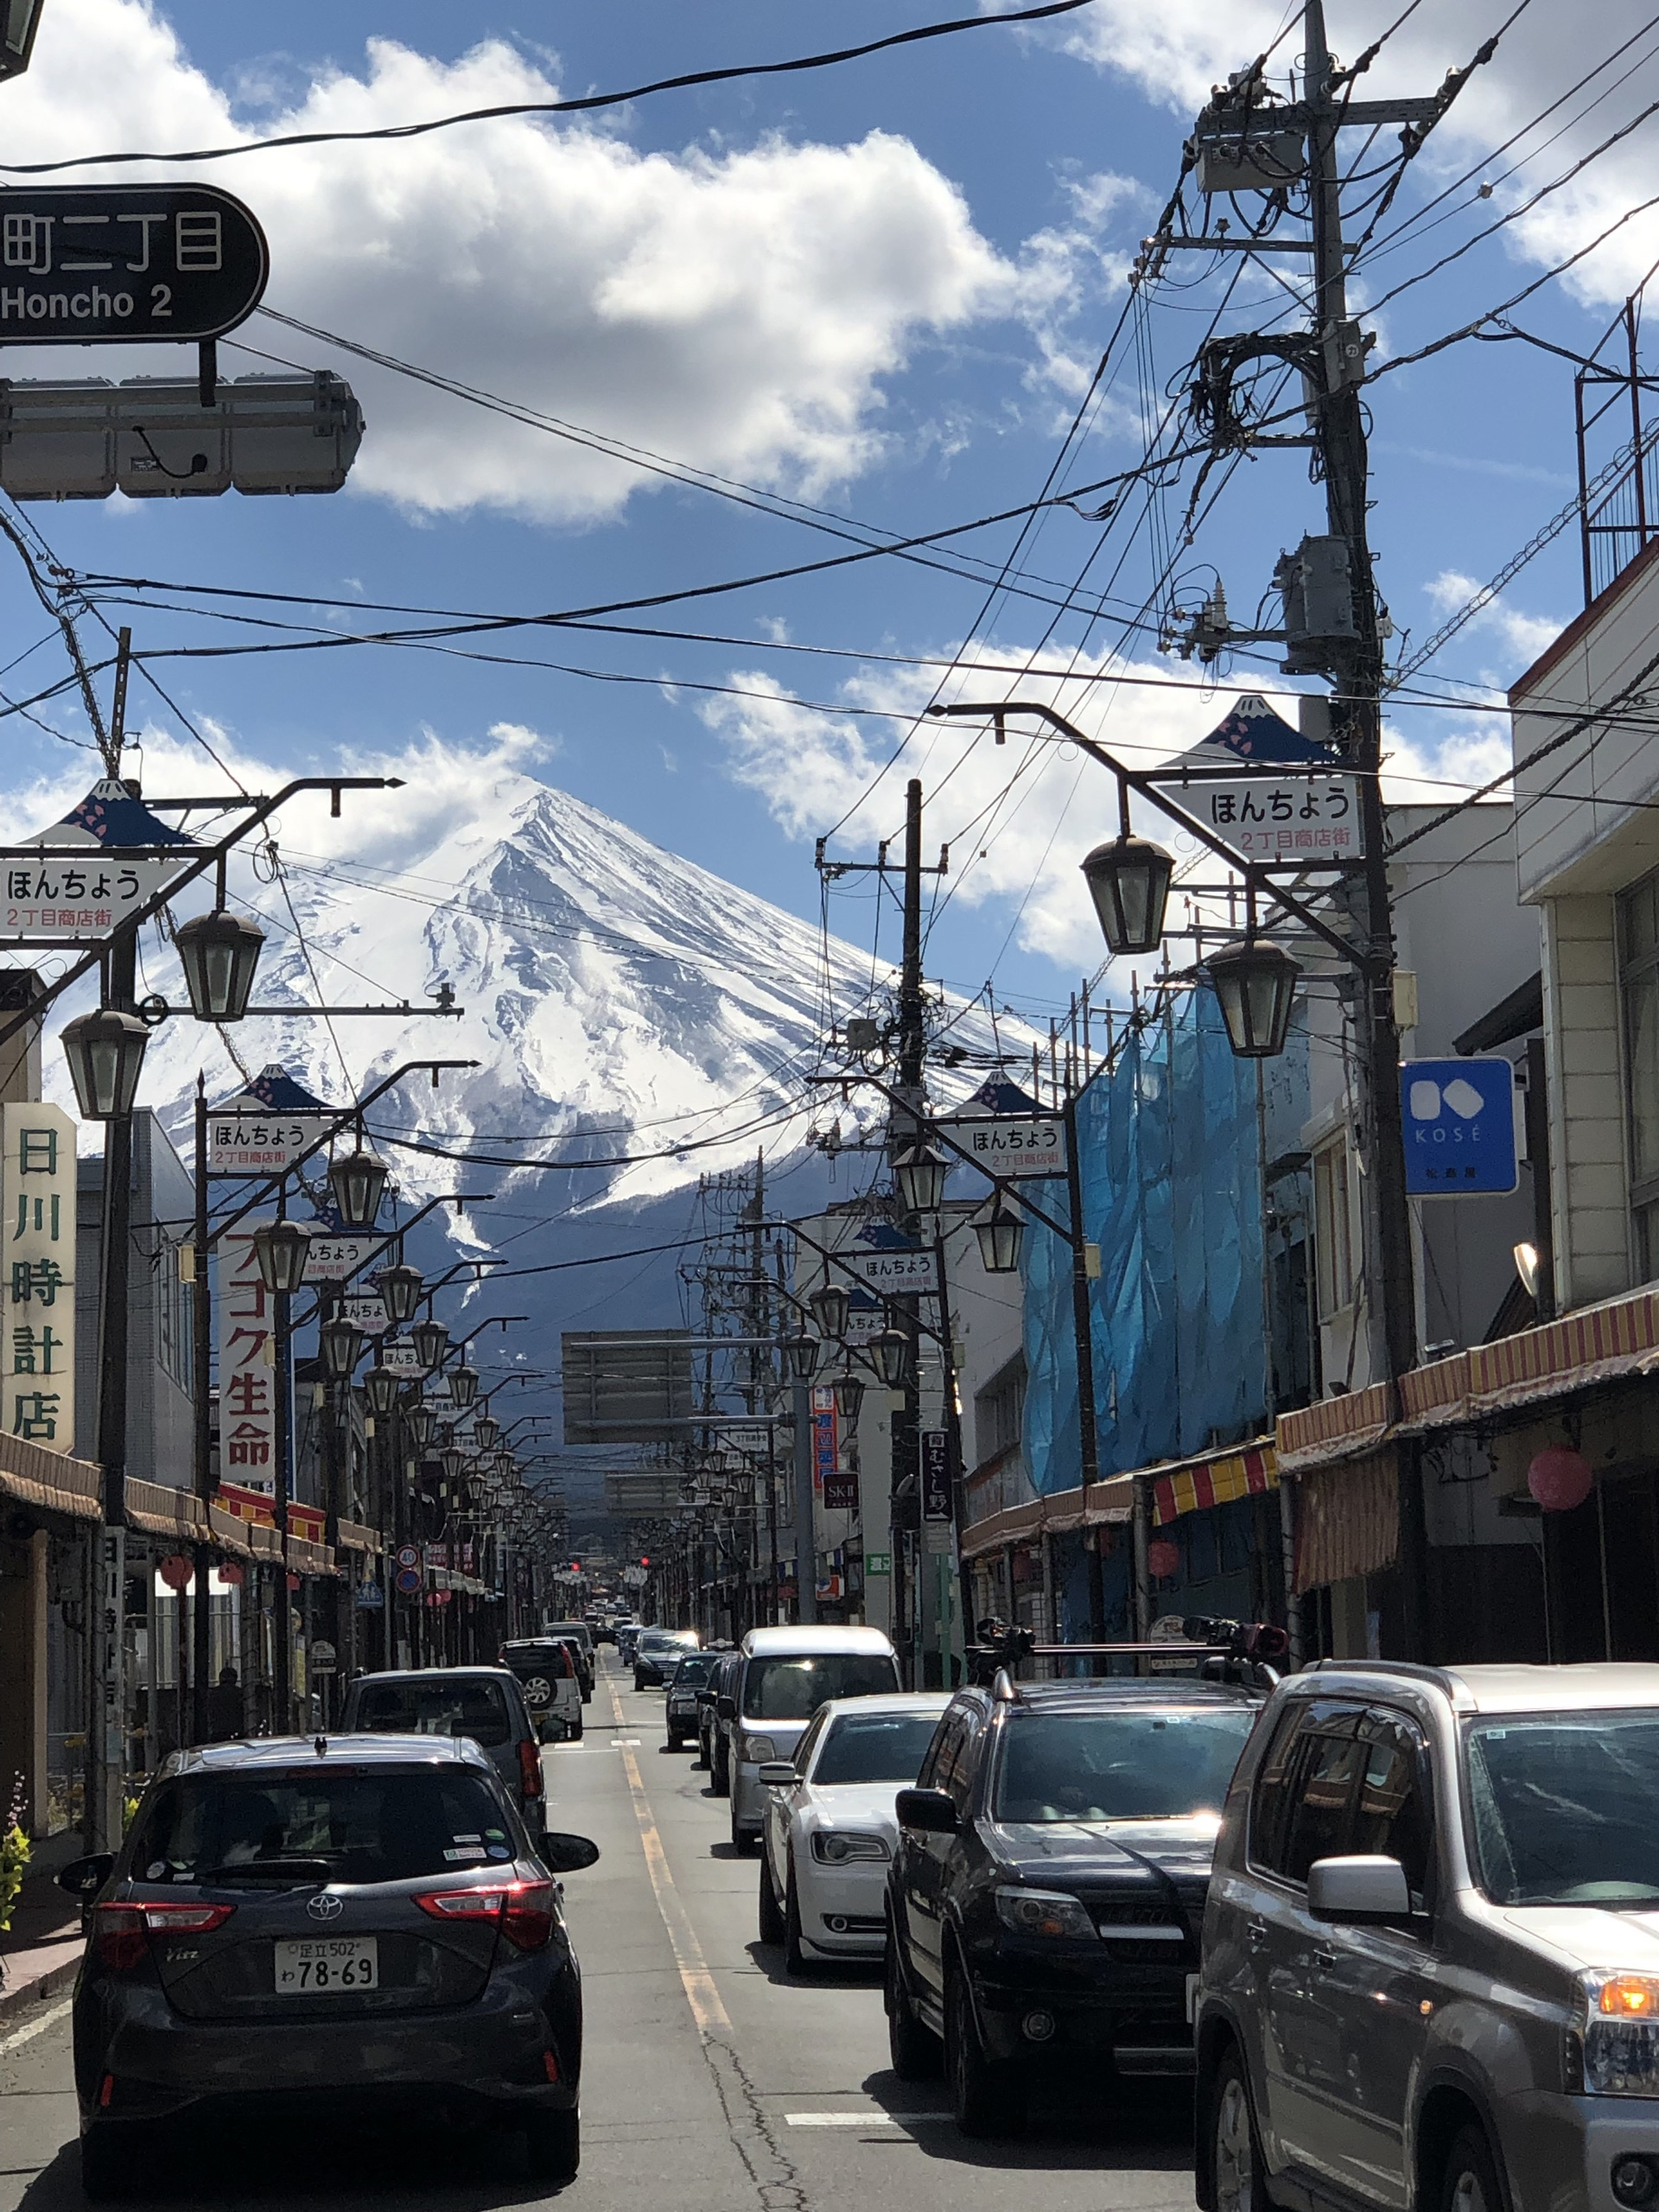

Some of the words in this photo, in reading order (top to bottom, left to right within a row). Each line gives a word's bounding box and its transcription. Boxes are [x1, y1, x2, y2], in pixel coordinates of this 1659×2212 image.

[3, 212, 222, 275] 町二丁目
[1, 285, 134, 319] Honcho
[150, 283, 172, 317] 2
[1212, 787, 1350, 824] ほんちょう
[1241, 827, 1351, 851] 2丁目商店街
[8, 869, 139, 899] ほんちょう
[7, 909, 112, 926] 2丁目商店街
[216, 1125, 304, 1146] ほんちょう
[973, 1128, 1058, 1151] ほんちょう
[215, 1151, 286, 1164] 2丁目商店街
[867, 1256, 931, 1276] ほんちょう
[12, 1128, 64, 1440] 日川時計店
[401, 1551, 414, 1563] 40
[300, 1944, 327, 1958] 足立
[329, 1942, 355, 1956] 502
[281, 1969, 295, 1982] わ
[298, 1959, 372, 1988] 78-69
